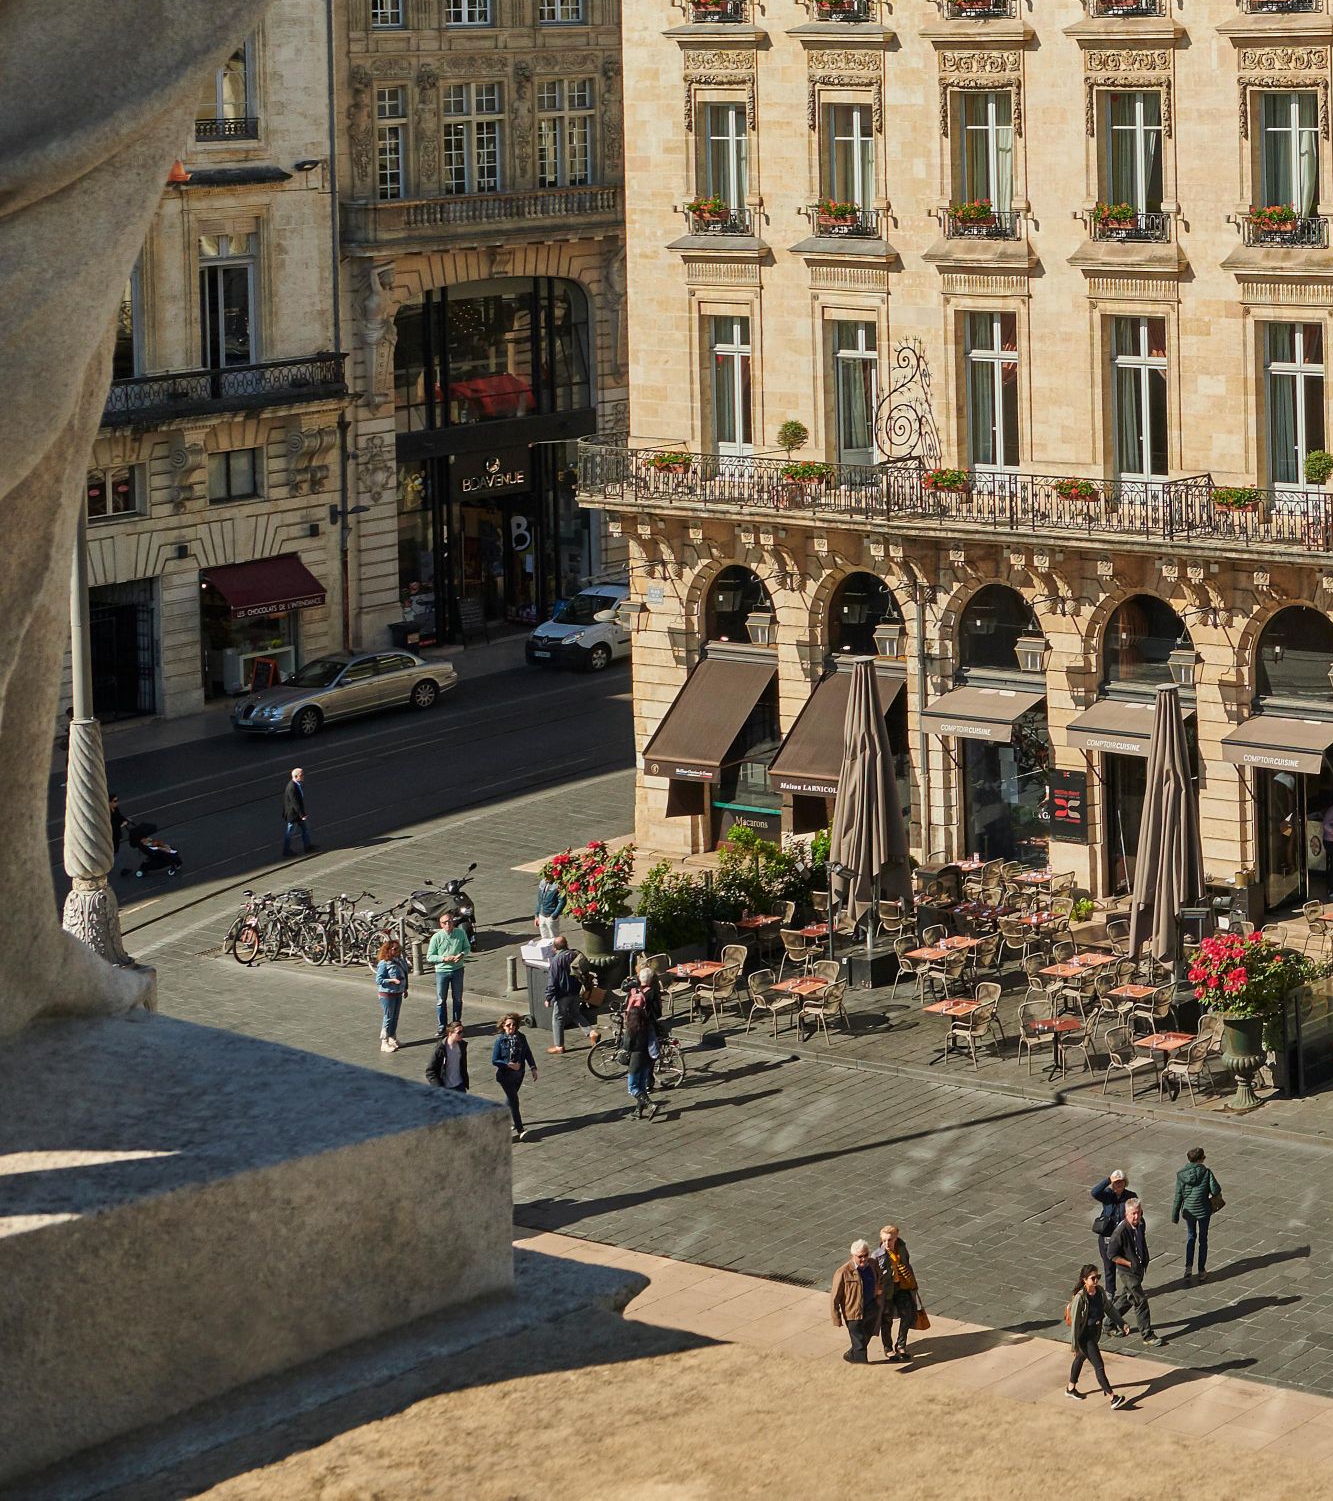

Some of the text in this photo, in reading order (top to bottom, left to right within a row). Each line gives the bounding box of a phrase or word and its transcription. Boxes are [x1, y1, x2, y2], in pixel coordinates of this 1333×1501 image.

[247, 604, 277, 616] CHOCOLATS
[780, 782, 838, 794] Maison LARNICOL
[735, 816, 769, 829] Macarons
